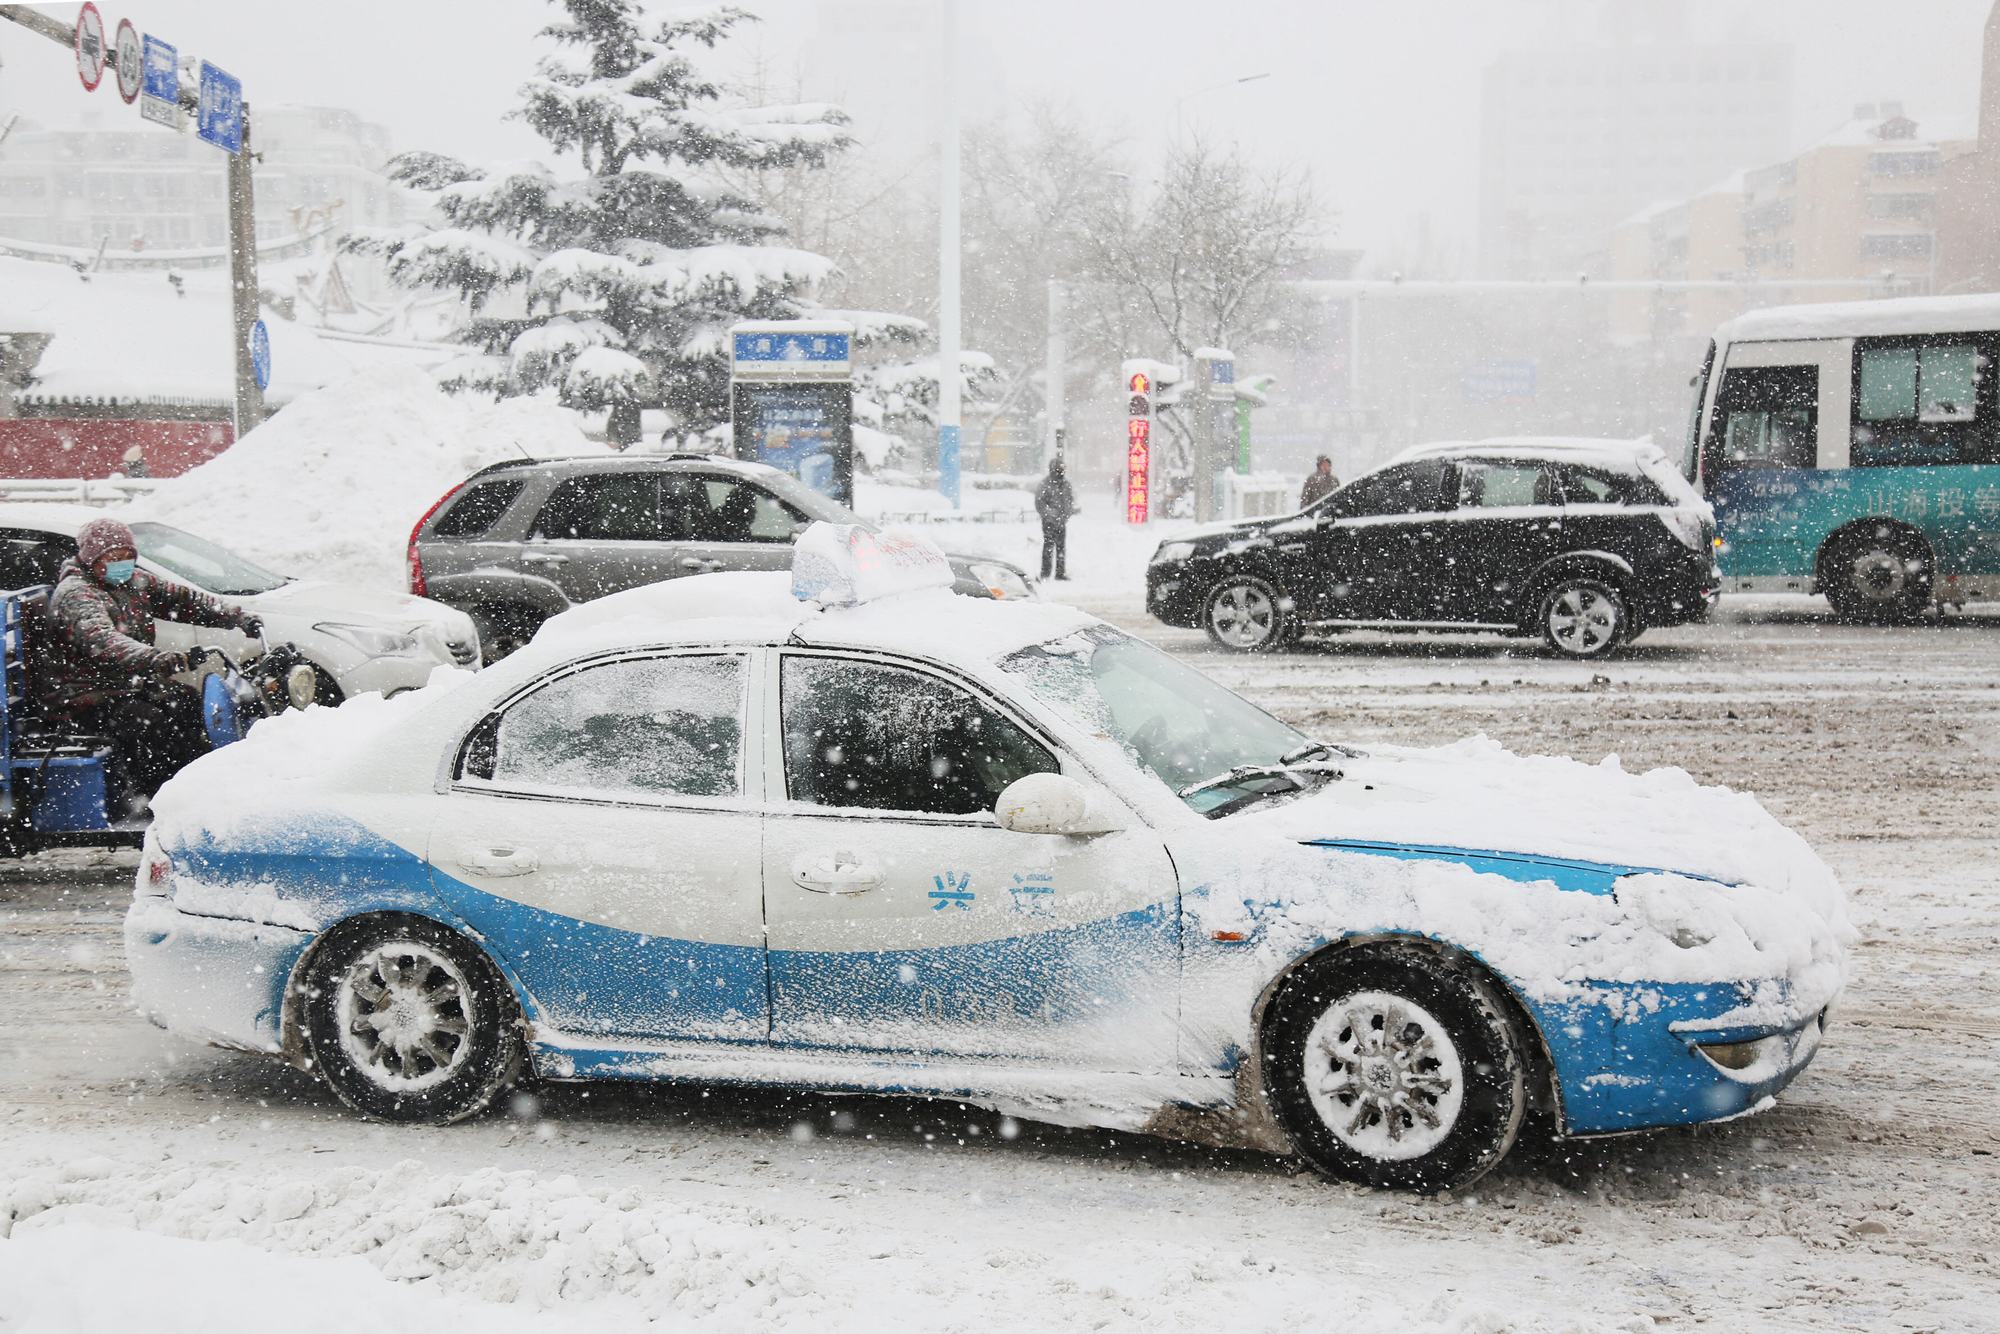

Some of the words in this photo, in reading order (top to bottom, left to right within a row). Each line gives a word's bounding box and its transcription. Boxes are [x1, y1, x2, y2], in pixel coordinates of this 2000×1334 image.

[1129, 420, 1149, 523] 行人禁止通行
